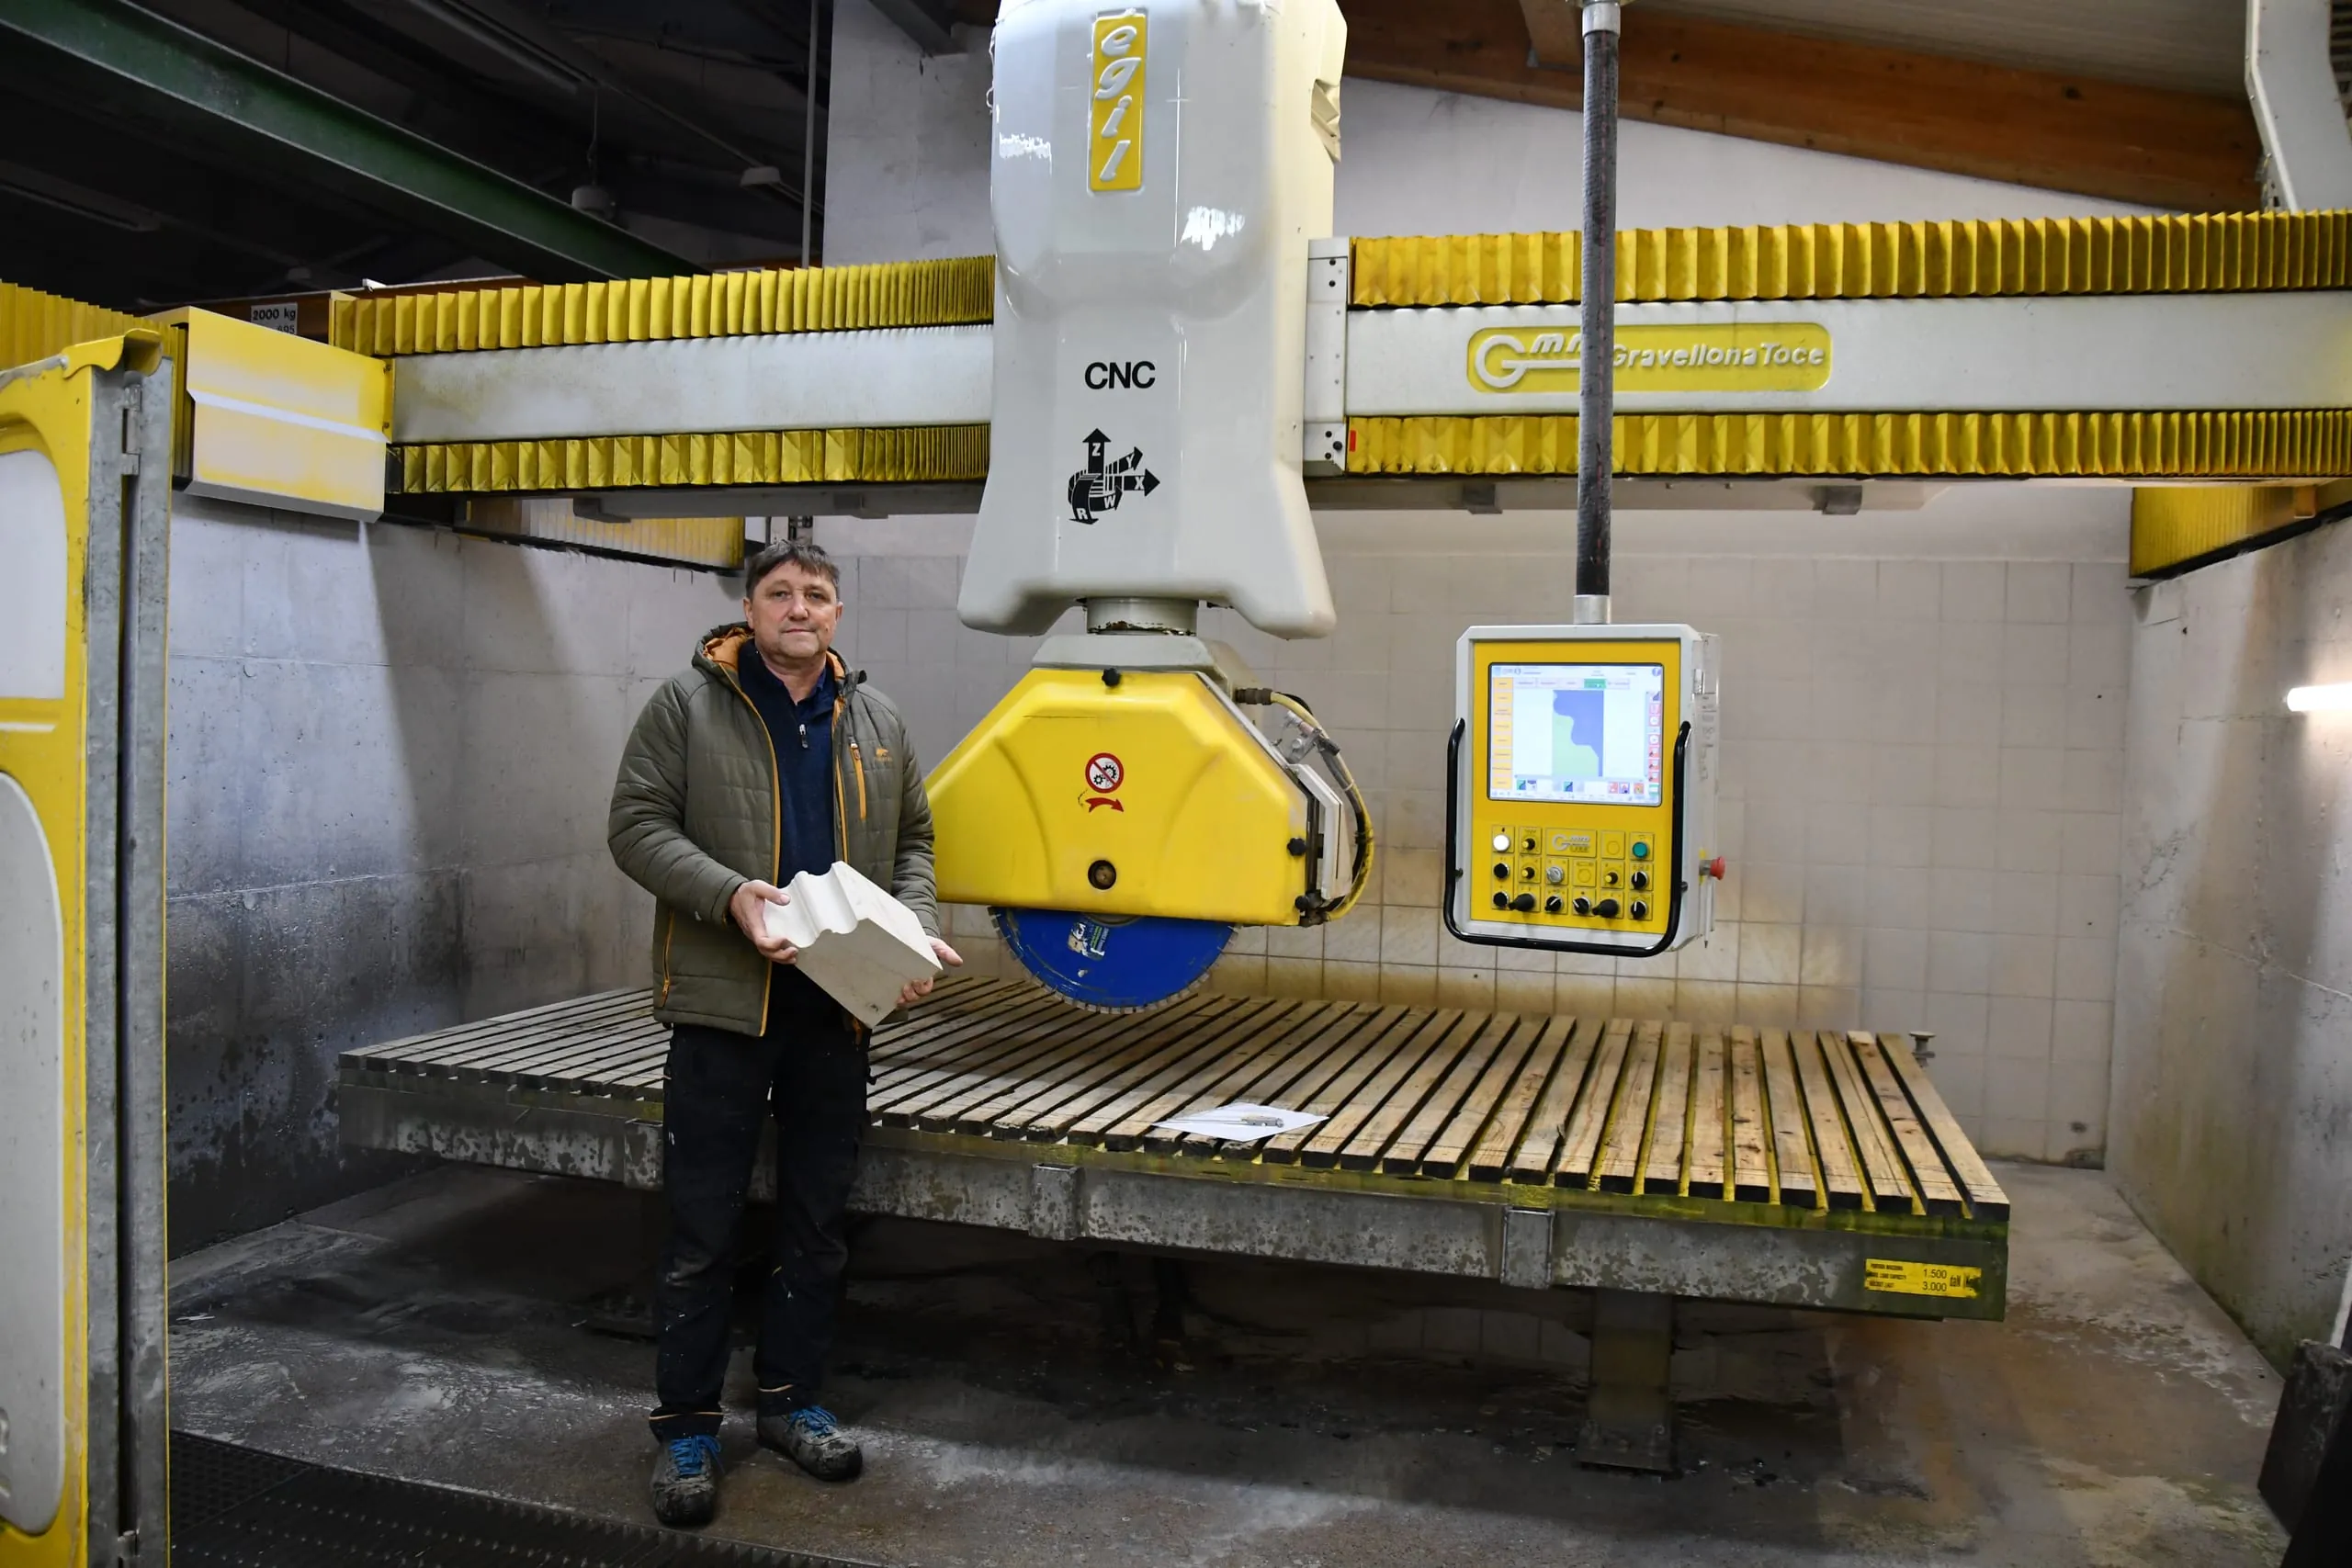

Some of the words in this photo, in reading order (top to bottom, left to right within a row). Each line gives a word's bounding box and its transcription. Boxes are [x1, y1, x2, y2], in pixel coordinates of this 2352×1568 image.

[254, 309, 279, 320] 2000
[284, 308, 296, 321] kg
[1613, 344, 1757, 367] Gravellona
[1760, 342, 1825, 366] Toce
[1085, 361, 1156, 389] CNC
[1091, 442, 1102, 457] Z
[1125, 453, 1136, 469] Y
[1134, 476, 1146, 491] X
[1103, 495, 1116, 509] W
[1076, 507, 1089, 521] R
